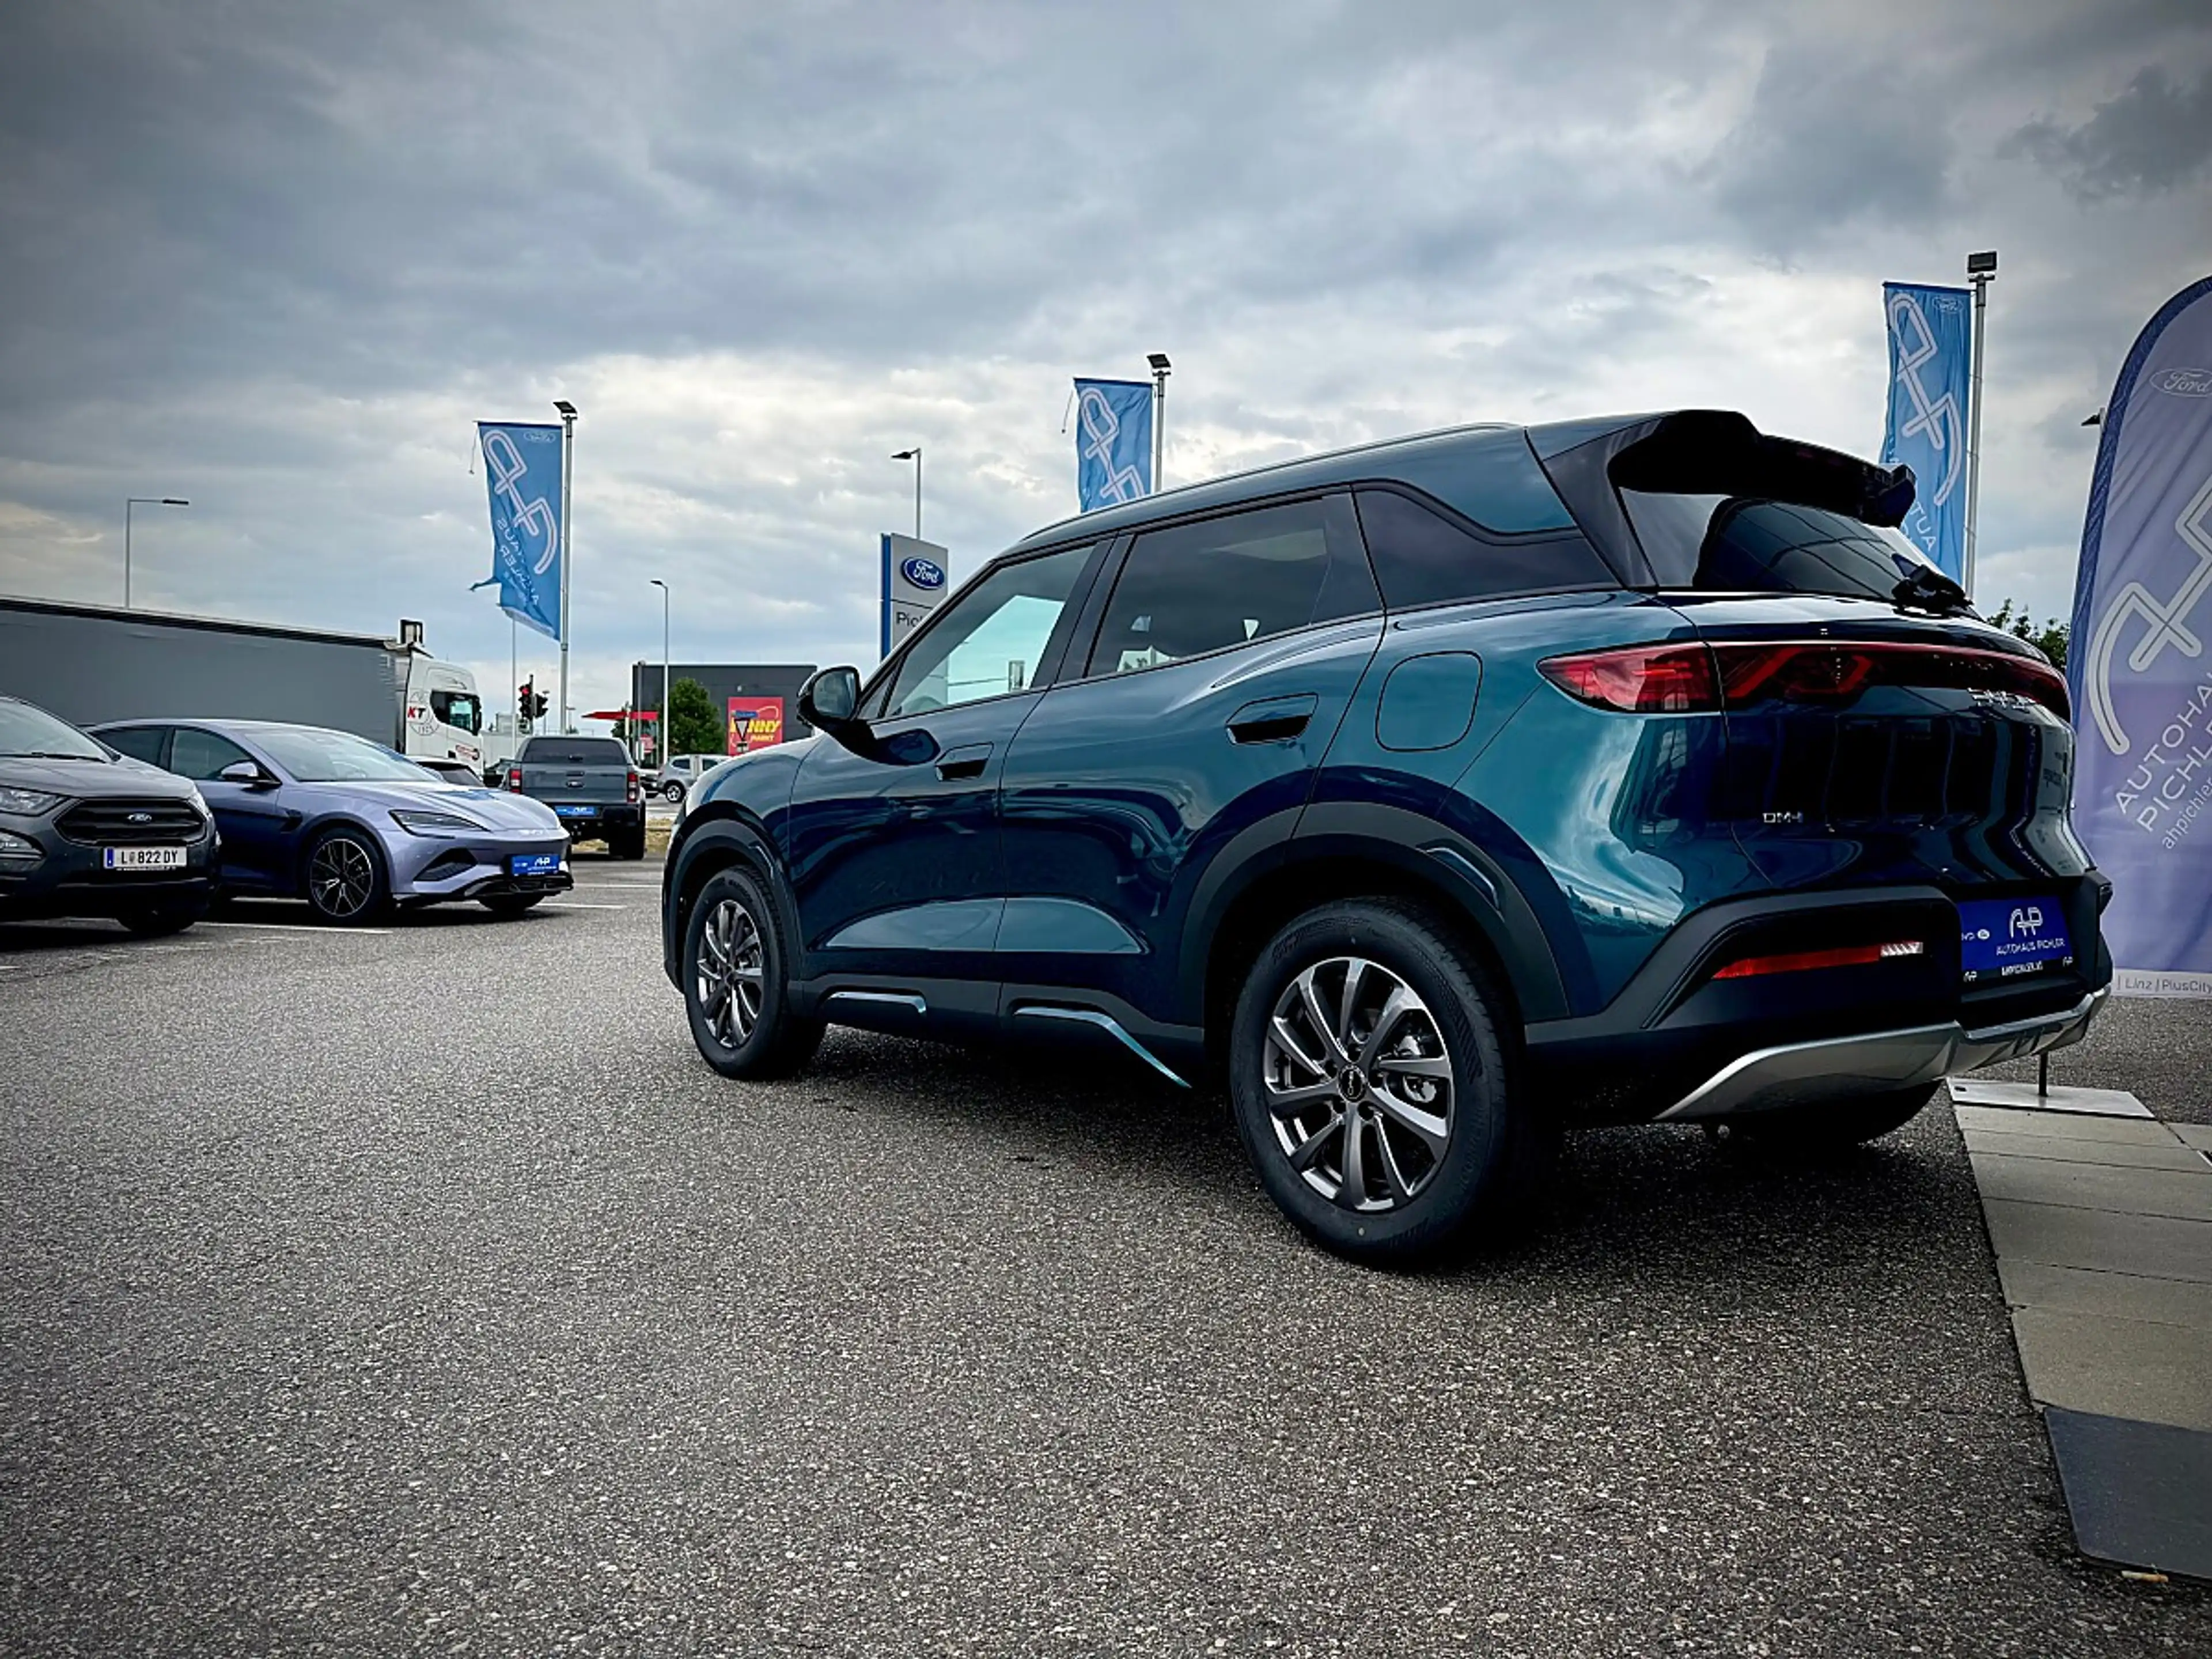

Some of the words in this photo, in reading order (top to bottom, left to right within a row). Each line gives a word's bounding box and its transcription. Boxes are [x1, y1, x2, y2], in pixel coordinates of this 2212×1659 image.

[2164, 372, 2212, 392] Ford
[912, 560, 940, 584] Ford
[895, 612, 924, 628] Pic
[2115, 672, 2212, 815] AUTOHA
[122, 851, 127, 864] L
[138, 850, 161, 863] 822
[164, 850, 178, 863] DY
[2125, 978, 2153, 990] Linz
